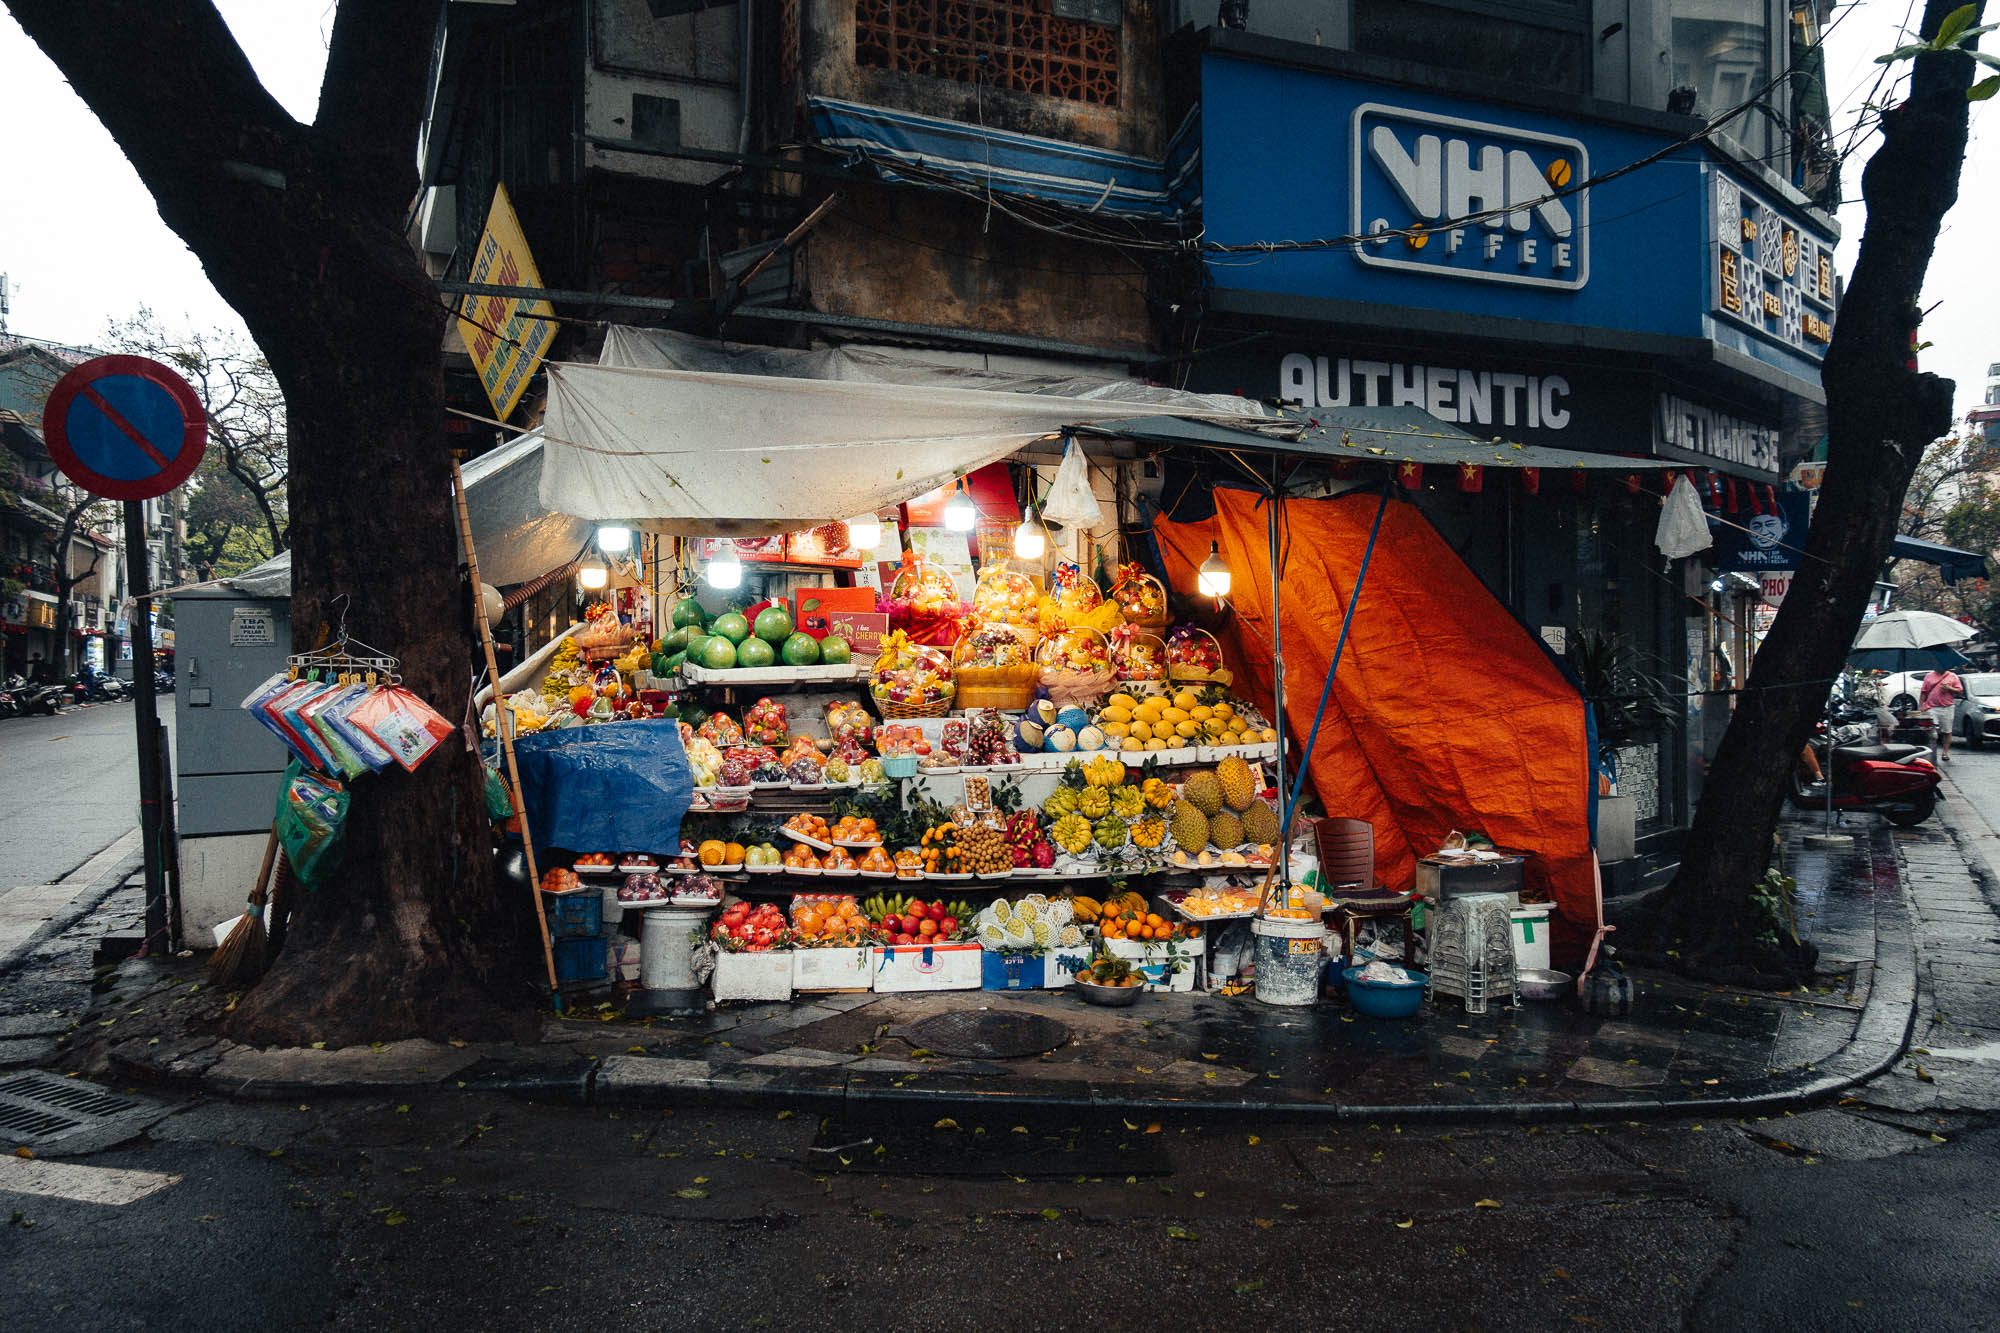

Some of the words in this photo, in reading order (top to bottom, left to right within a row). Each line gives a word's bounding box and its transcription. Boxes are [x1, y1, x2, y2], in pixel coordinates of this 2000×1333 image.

[1764, 291, 1782, 317] FEEL
[1808, 315, 1831, 344] RELIVE
[1280, 353, 1570, 429] AUTHENTIC
[1660, 392, 1780, 473] VIETNAMESE
[1762, 571, 1786, 596] PHỞ
[855, 631, 883, 641] CHERRY
